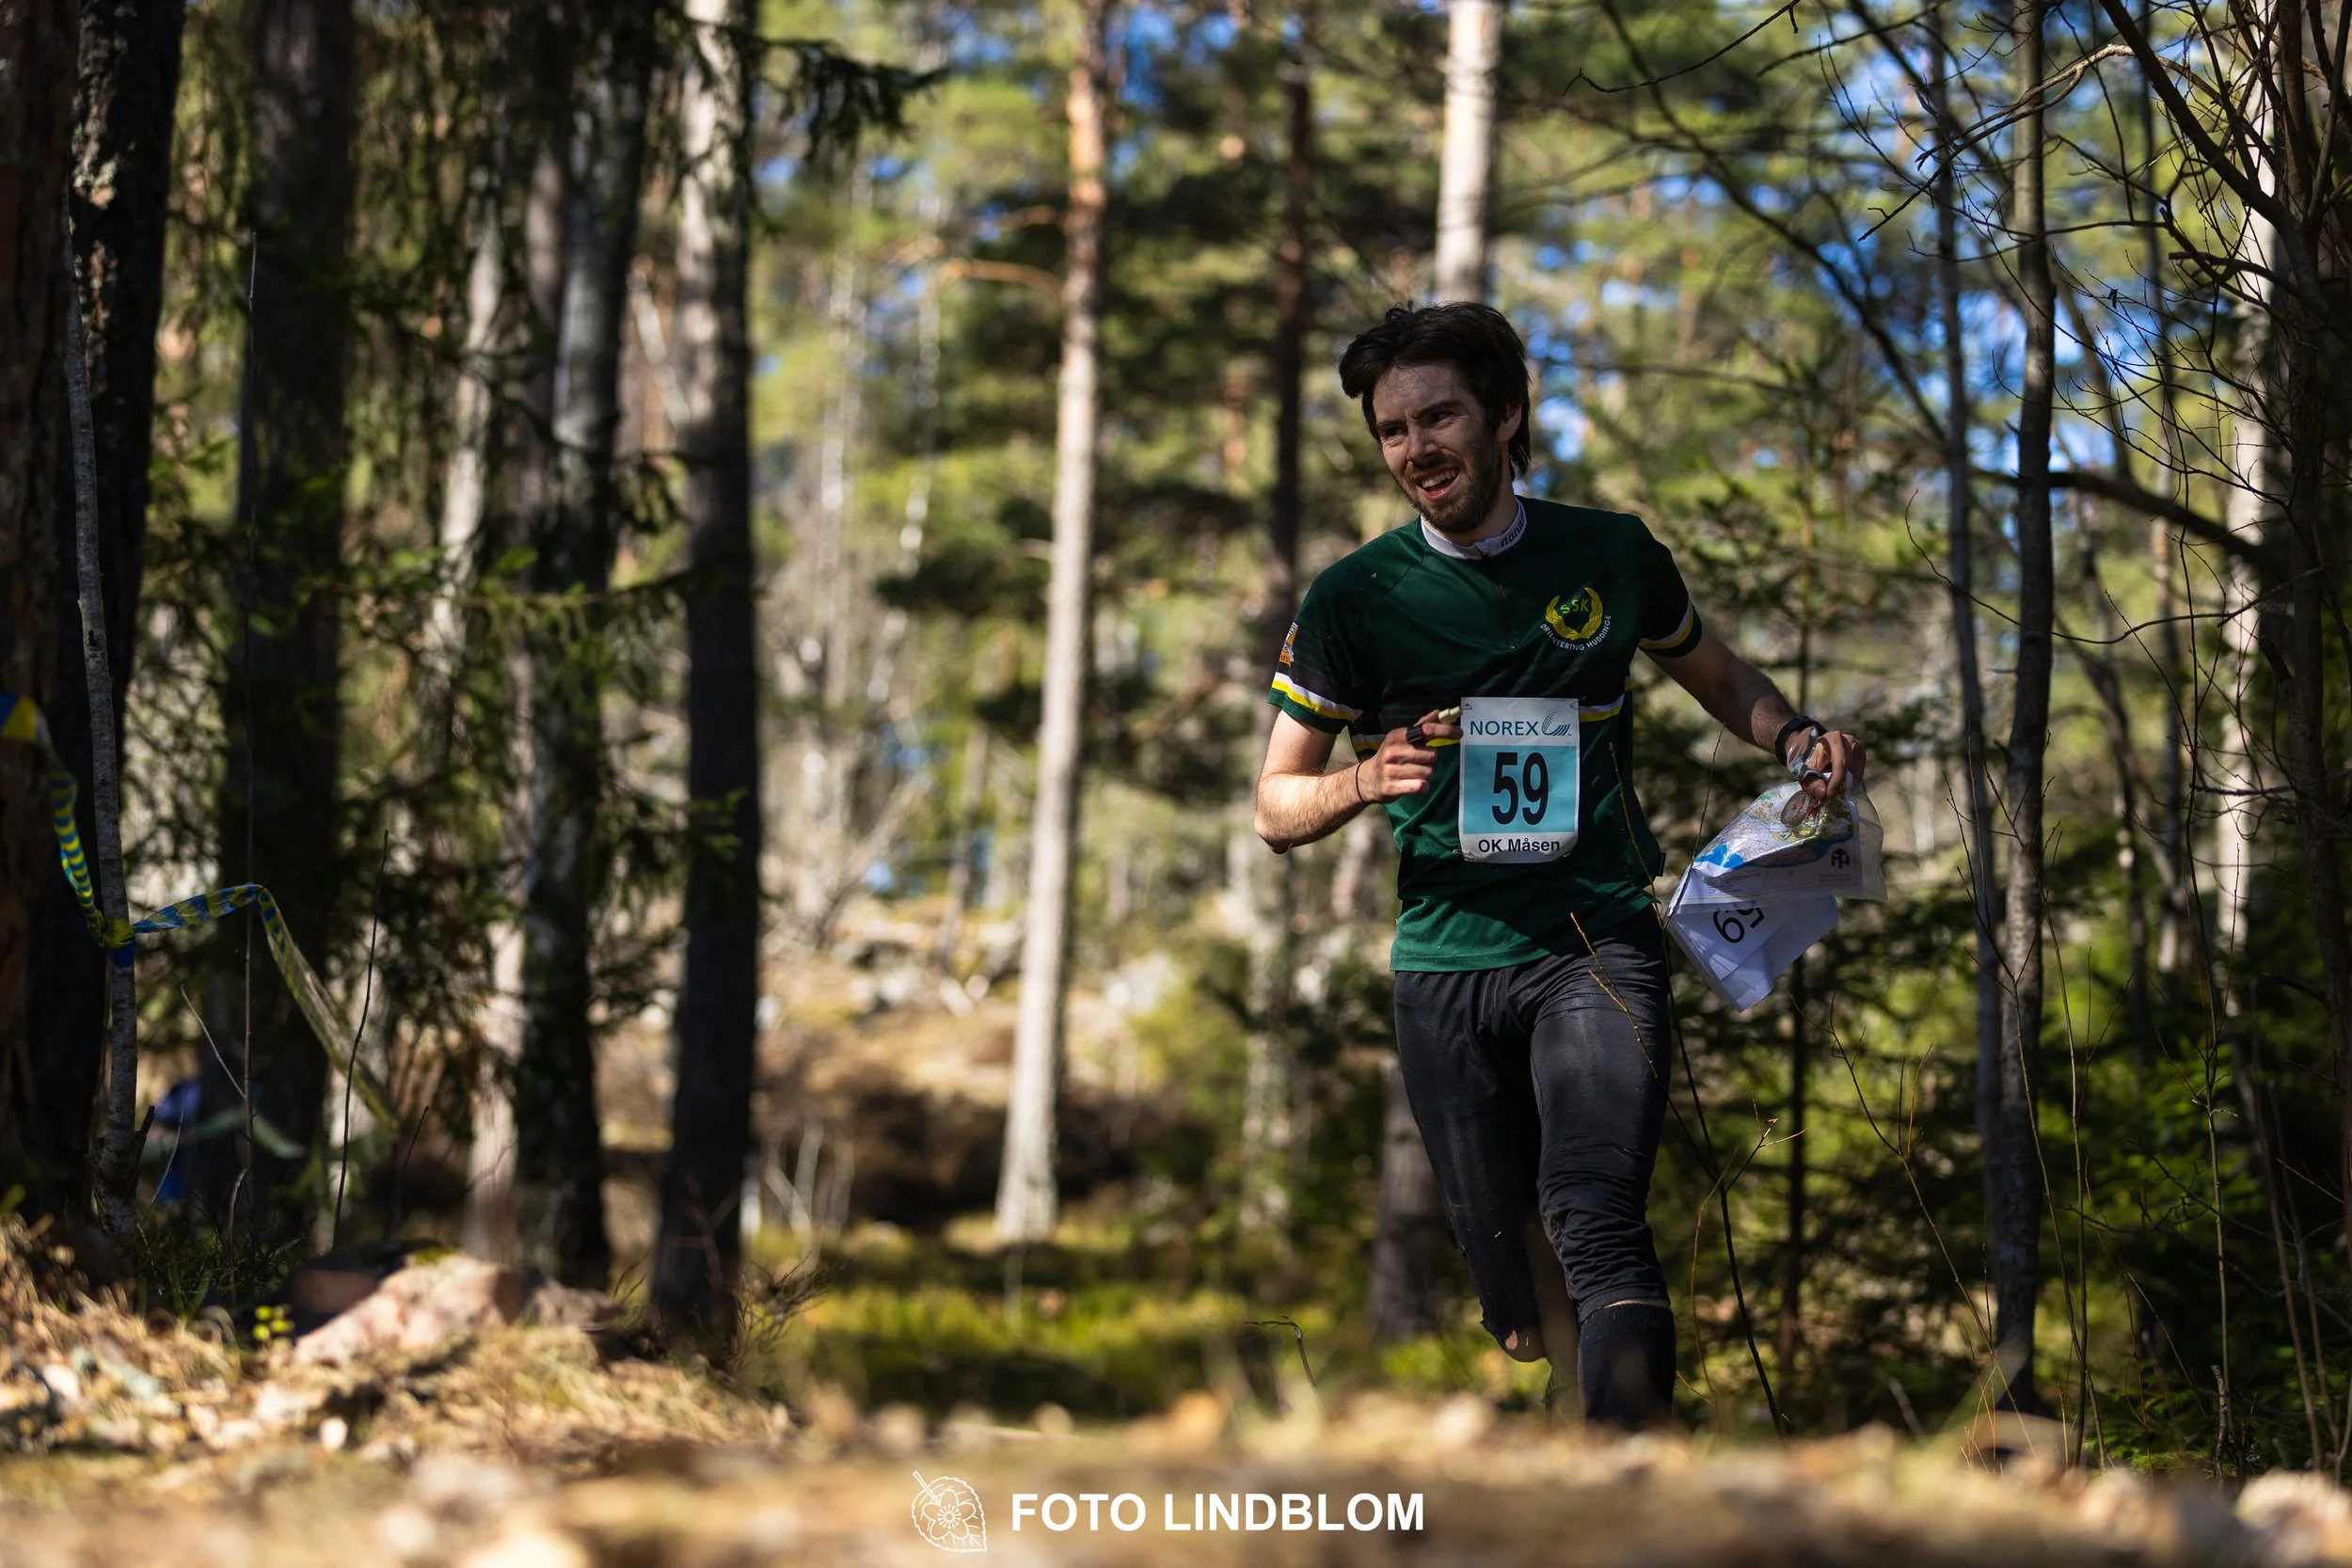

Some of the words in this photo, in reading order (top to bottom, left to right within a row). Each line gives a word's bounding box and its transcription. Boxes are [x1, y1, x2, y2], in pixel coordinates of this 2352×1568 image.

[1560, 598, 1589, 614] SSK
[1540, 624, 1585, 651] ORIENTERING
[1586, 614, 1612, 648] HUDDINGE
[1470, 721, 1539, 736] NOREX
[1491, 752, 1549, 826] 59
[1478, 839, 1502, 853] OK
[1508, 838, 1560, 852] Måsen
